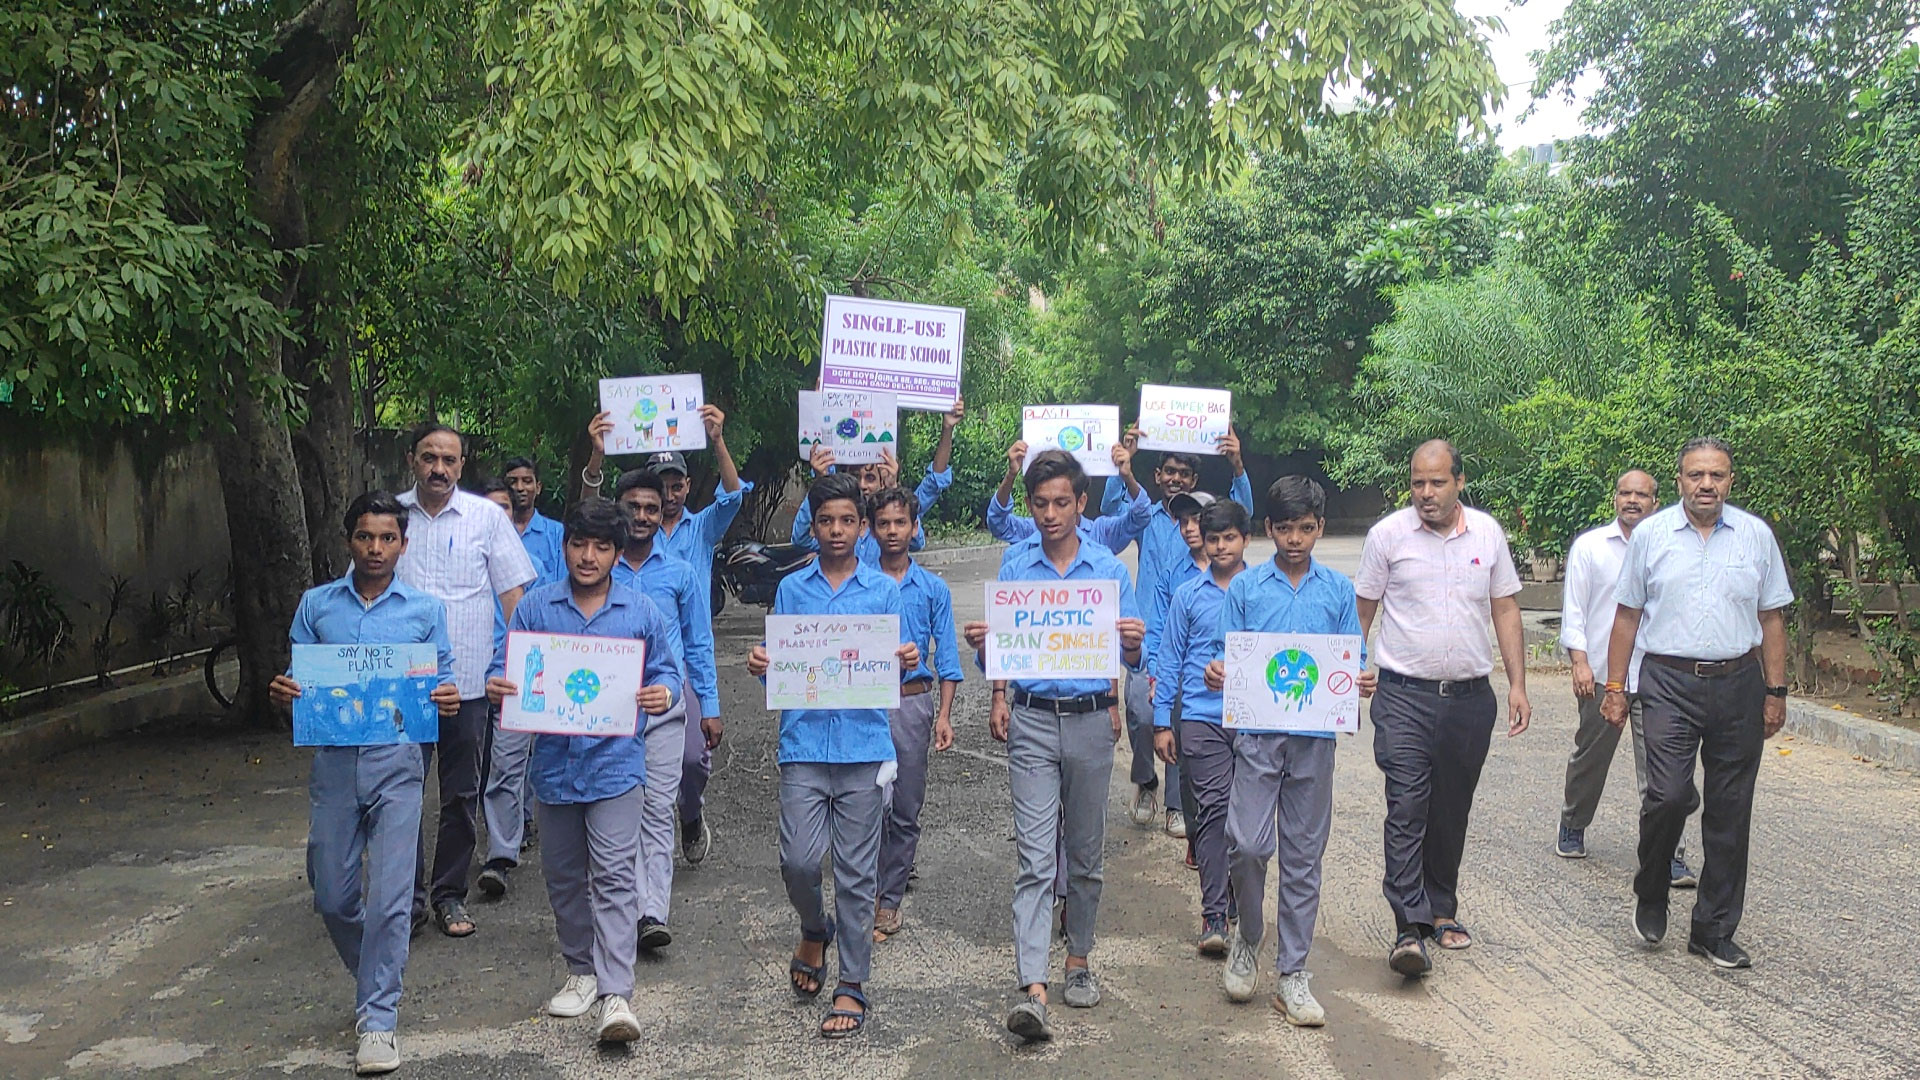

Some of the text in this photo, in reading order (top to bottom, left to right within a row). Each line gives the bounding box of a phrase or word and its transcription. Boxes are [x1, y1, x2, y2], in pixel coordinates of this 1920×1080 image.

[842, 312, 946, 338] SINGLE-USE
[831, 338, 952, 365] PLASTIC FREE SCHOOL
[832, 369, 850, 378] DCM
[931, 379, 959, 388] SCHOOL
[606, 383, 672, 399] SAY NO TO
[1145, 400, 1226, 414] USE PAPER BAG
[1165, 413, 1208, 430] STOP
[615, 435, 681, 451] PLASTIC
[1147, 426, 1198, 444] PLASTIC
[995, 588, 1103, 606] SAY NO TO
[1014, 609, 1095, 628] PLASTIC
[793, 622, 872, 636] SAY NO TO
[550, 637, 636, 656] SAY NO PLASTIC
[778, 638, 828, 649] PLASTIC
[995, 631, 1110, 652] BAN SINGLE
[337, 646, 360, 658] SAY
[365, 648, 380, 658] NO
[348, 657, 393, 672] PLASTIC
[773, 660, 891, 673] SAVE EARTH
[1000, 653, 1109, 673] USE PLASTIC
